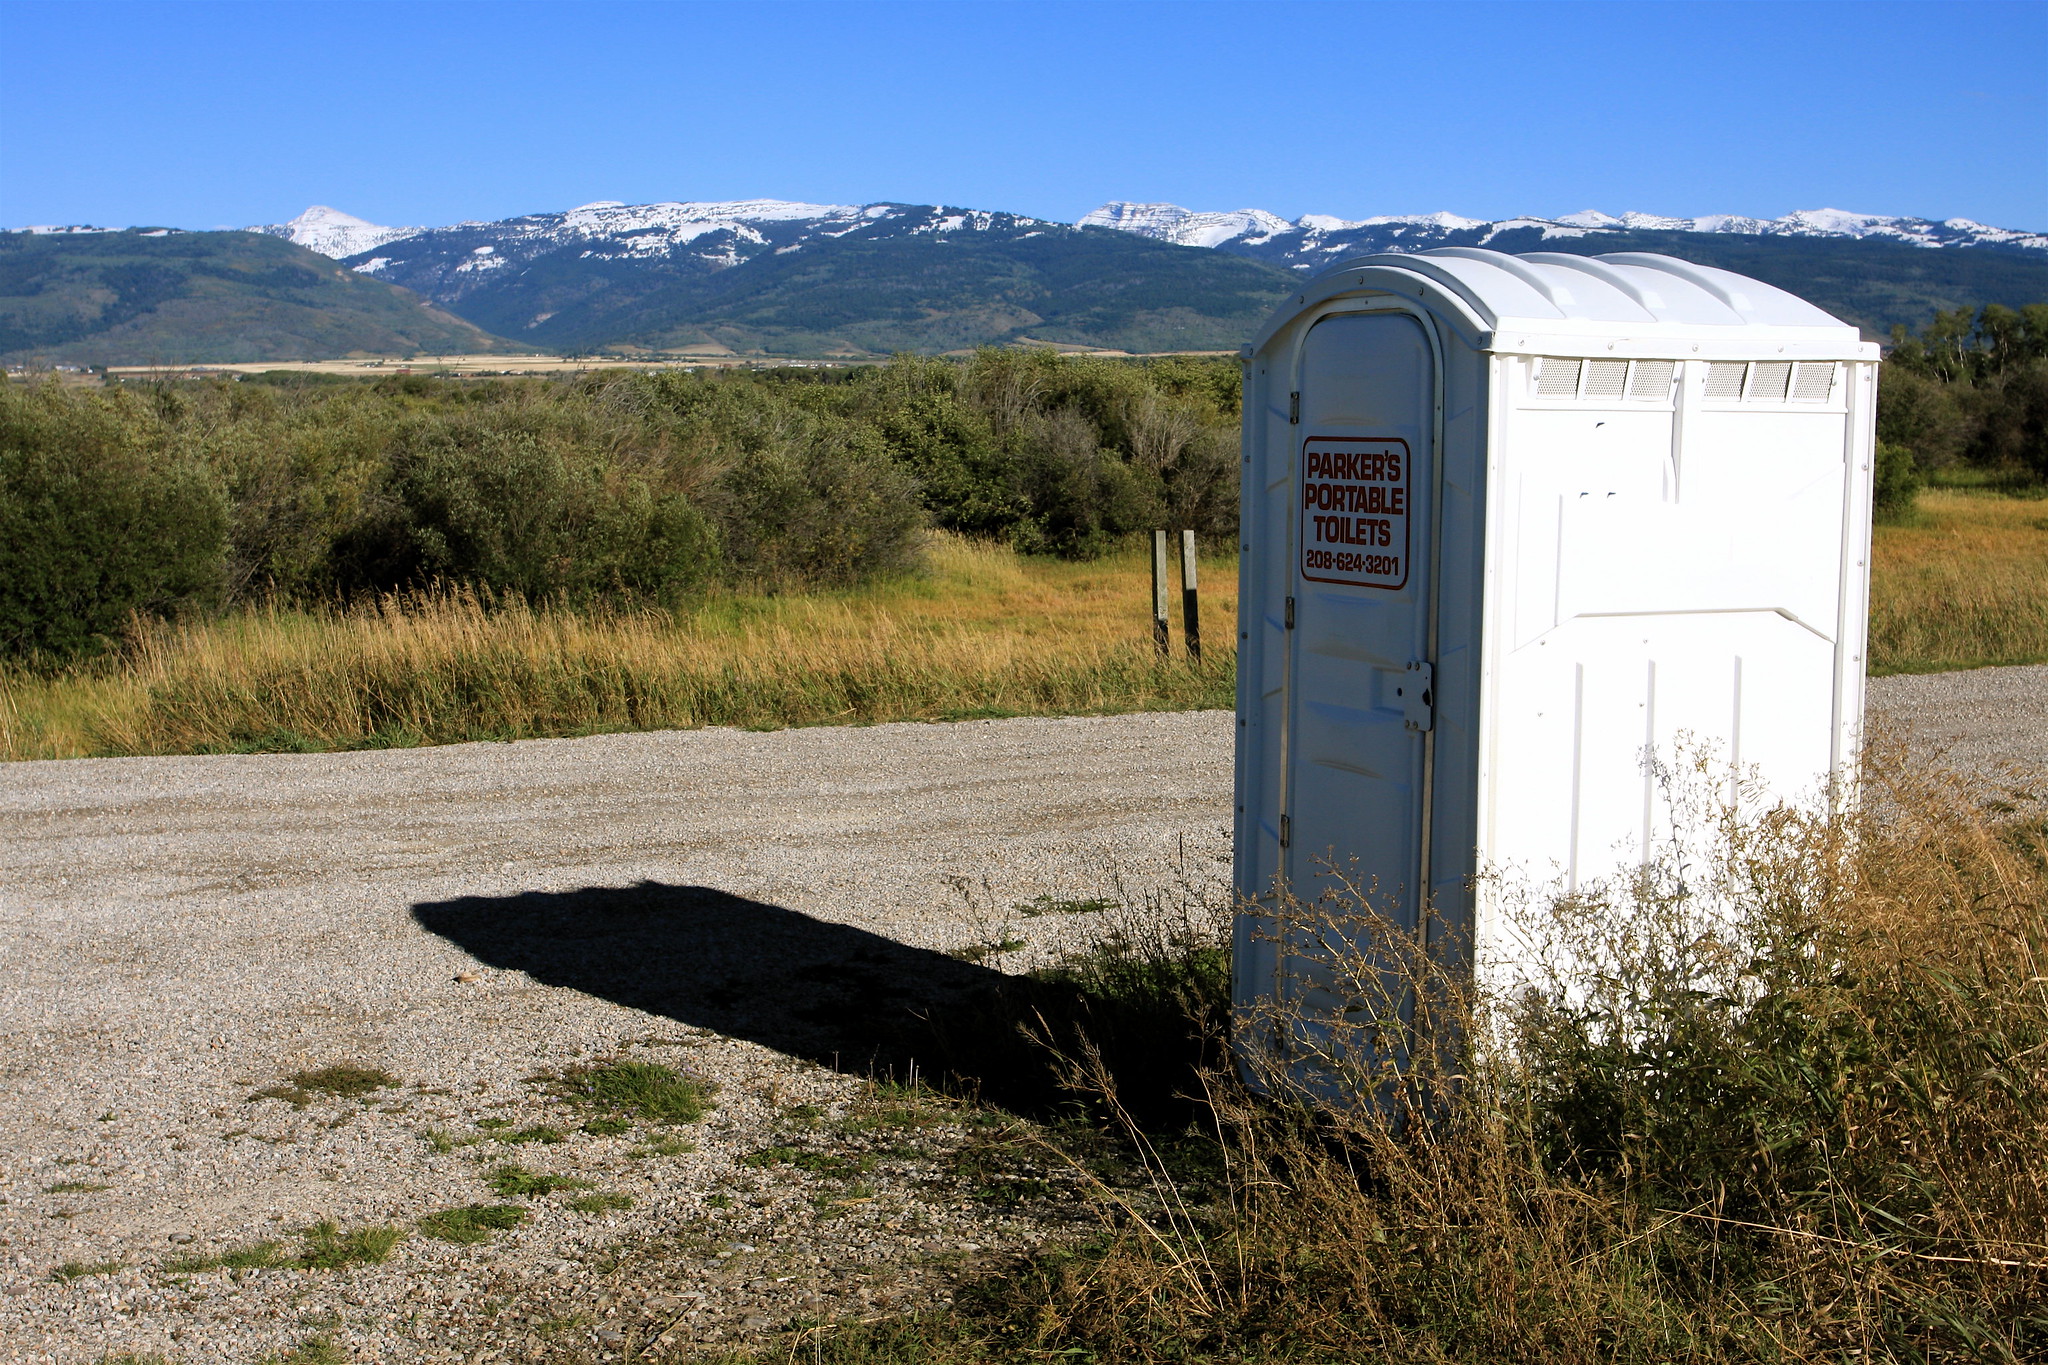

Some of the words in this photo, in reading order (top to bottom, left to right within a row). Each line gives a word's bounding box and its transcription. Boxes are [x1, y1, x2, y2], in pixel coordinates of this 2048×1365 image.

[1307, 450, 1401, 482] PARKER'S
[1305, 483, 1404, 515] PORTABLE
[1313, 515, 1391, 547] TOILETS
